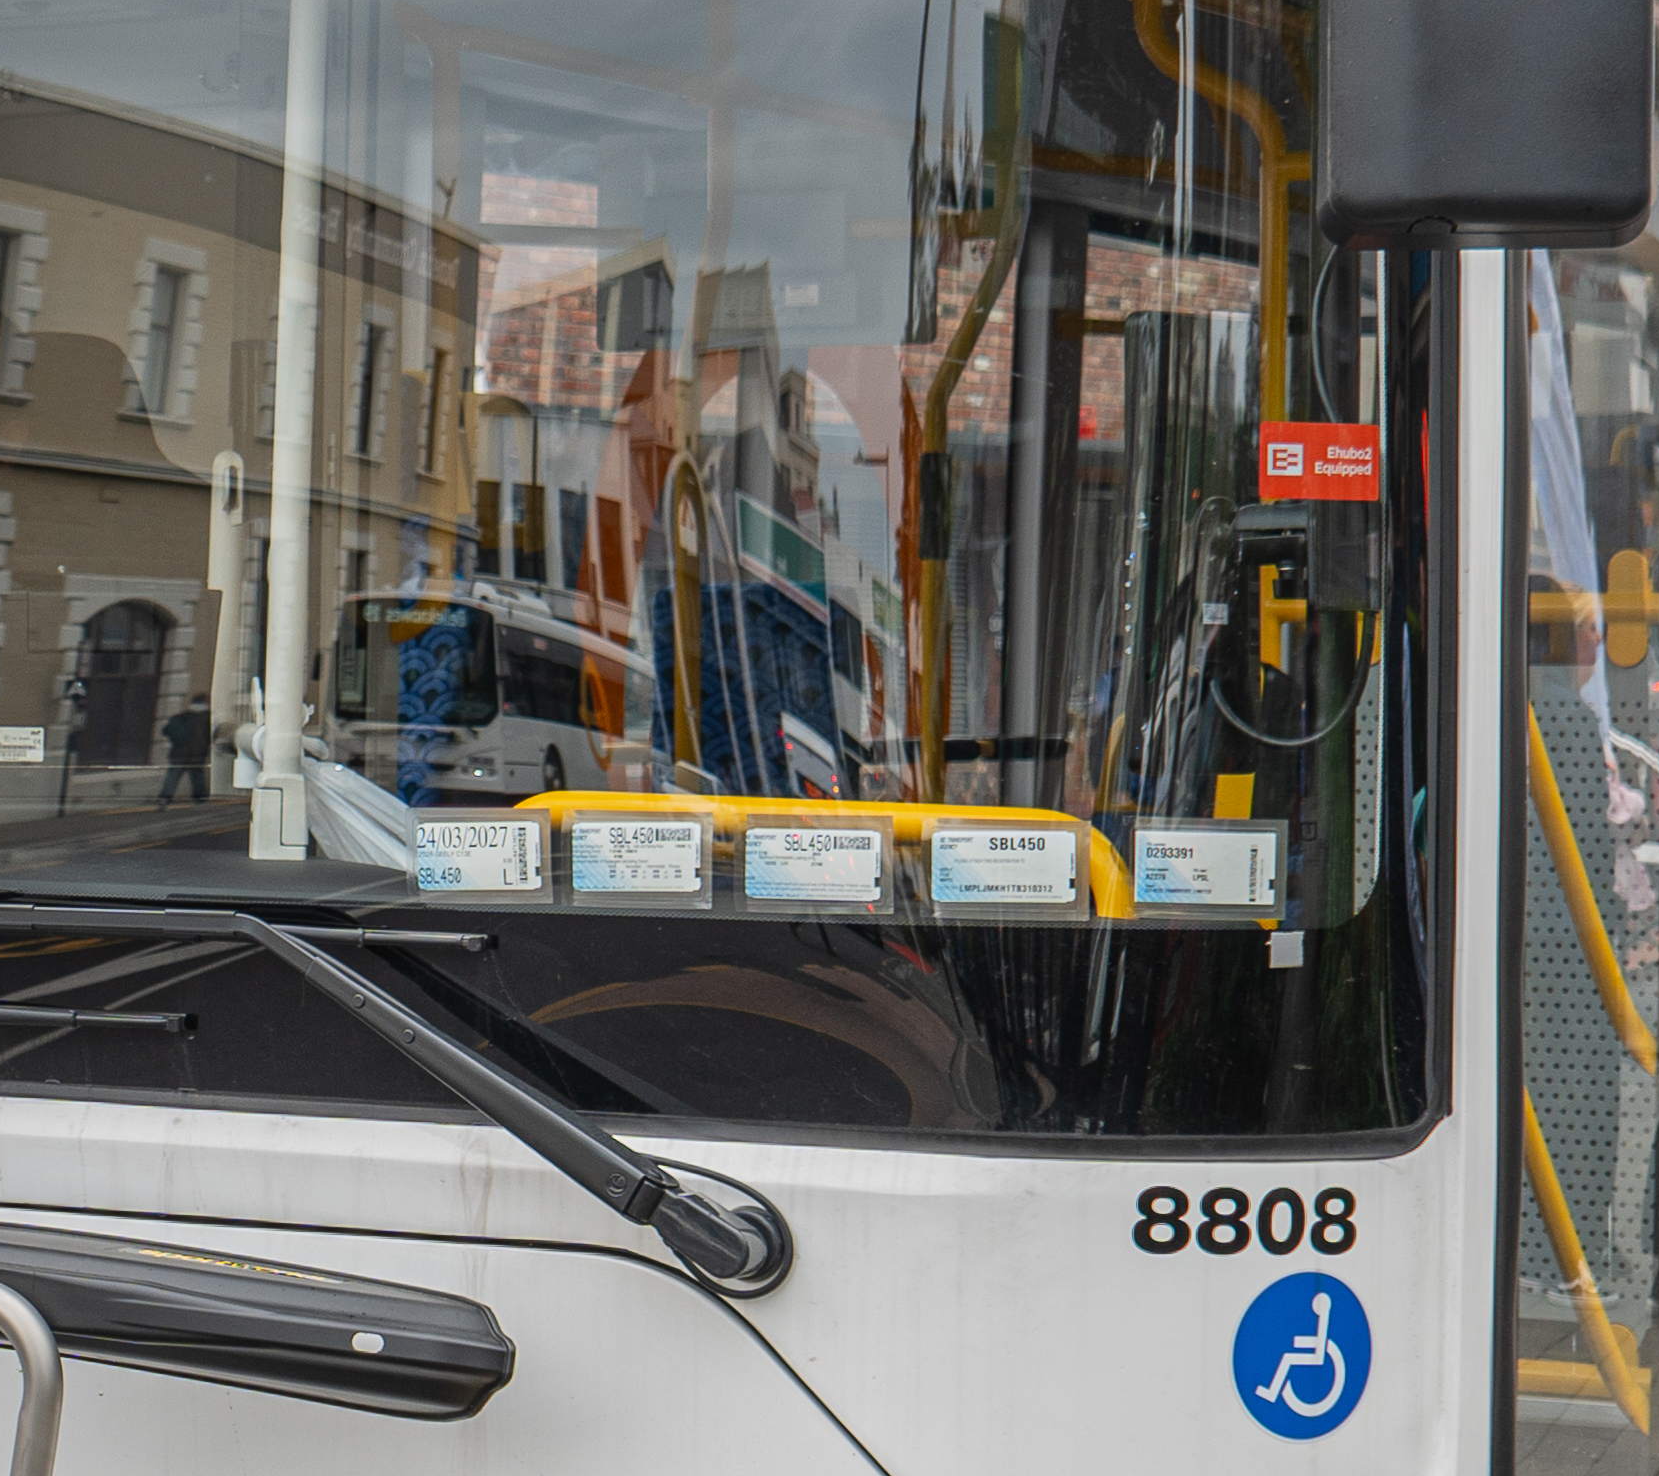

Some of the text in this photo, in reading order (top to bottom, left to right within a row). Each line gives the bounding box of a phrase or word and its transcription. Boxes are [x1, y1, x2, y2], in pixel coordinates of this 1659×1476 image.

[1327, 446, 1372, 460] Ehubo2
[1315, 461, 1372, 477] Equipped
[417, 827, 508, 851] 24/03/2027
[609, 827, 654, 844] SBL450
[784, 834, 831, 852] SBL450
[989, 837, 1046, 851] SBL450
[418, 867, 462, 885] SBL450
[503, 868, 514, 885] L
[1133, 1185, 1358, 1258] 8808
